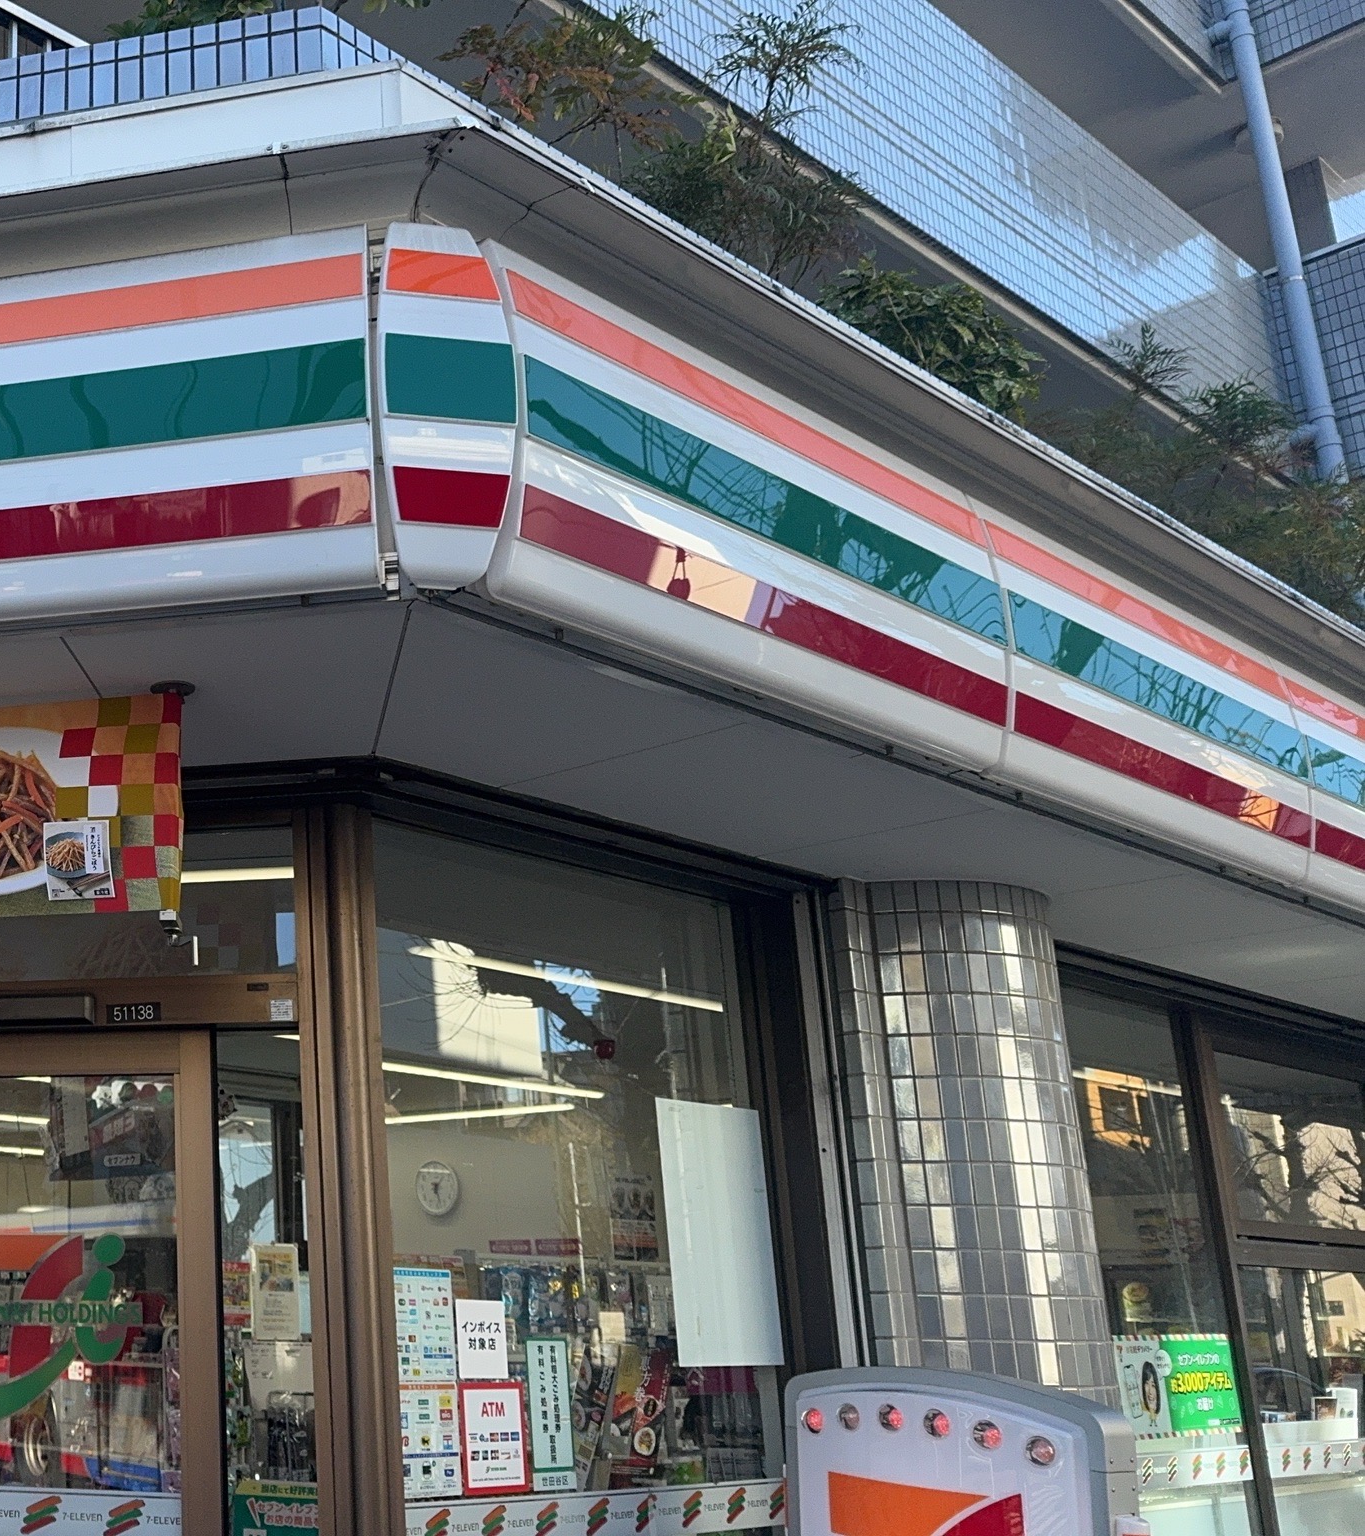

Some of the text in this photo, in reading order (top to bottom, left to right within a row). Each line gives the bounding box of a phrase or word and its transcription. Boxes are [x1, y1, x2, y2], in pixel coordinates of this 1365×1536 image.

[113, 1005, 154, 1021] 51138
[39, 1302, 143, 1325] HOLDINGS
[461, 1321, 502, 1334] インボイス
[468, 1337, 497, 1351] 対象店
[1170, 1372, 1233, 1394] 約3,000アイテム
[480, 1402, 506, 1418] ATM
[542, 1475, 569, 1487] 世田谷区
[261, 1484, 318, 1496] 当店にて好評実
